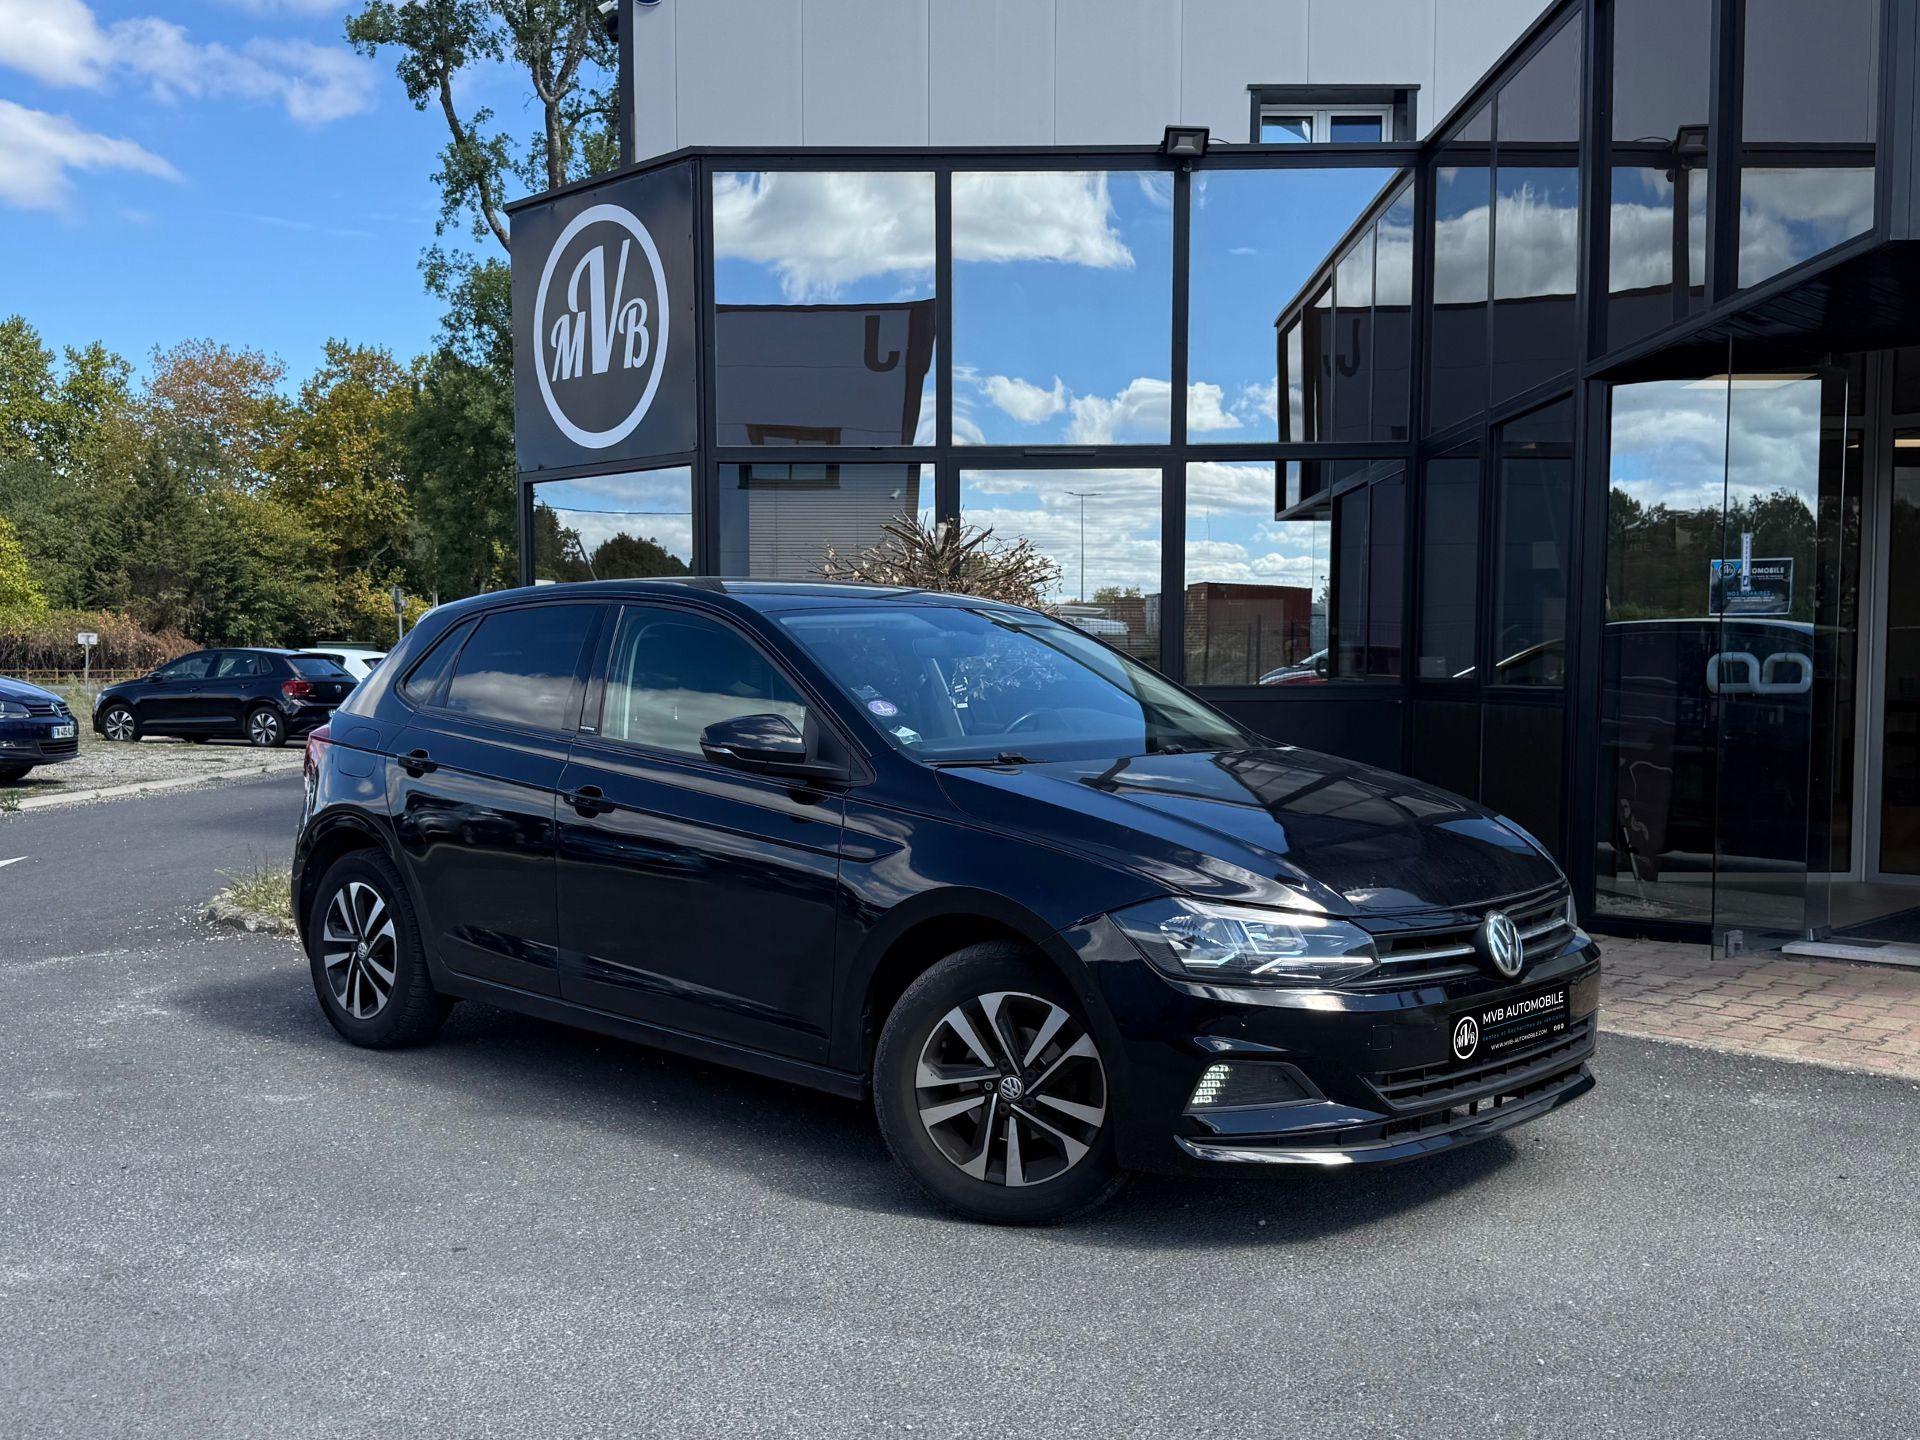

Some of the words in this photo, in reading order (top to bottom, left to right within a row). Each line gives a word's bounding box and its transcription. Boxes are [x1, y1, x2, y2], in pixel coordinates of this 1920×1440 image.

[551, 239, 649, 382] MVB
[1482, 1009, 1504, 1025] MVB
[1506, 991, 1564, 1019] AUTOMOBILE
